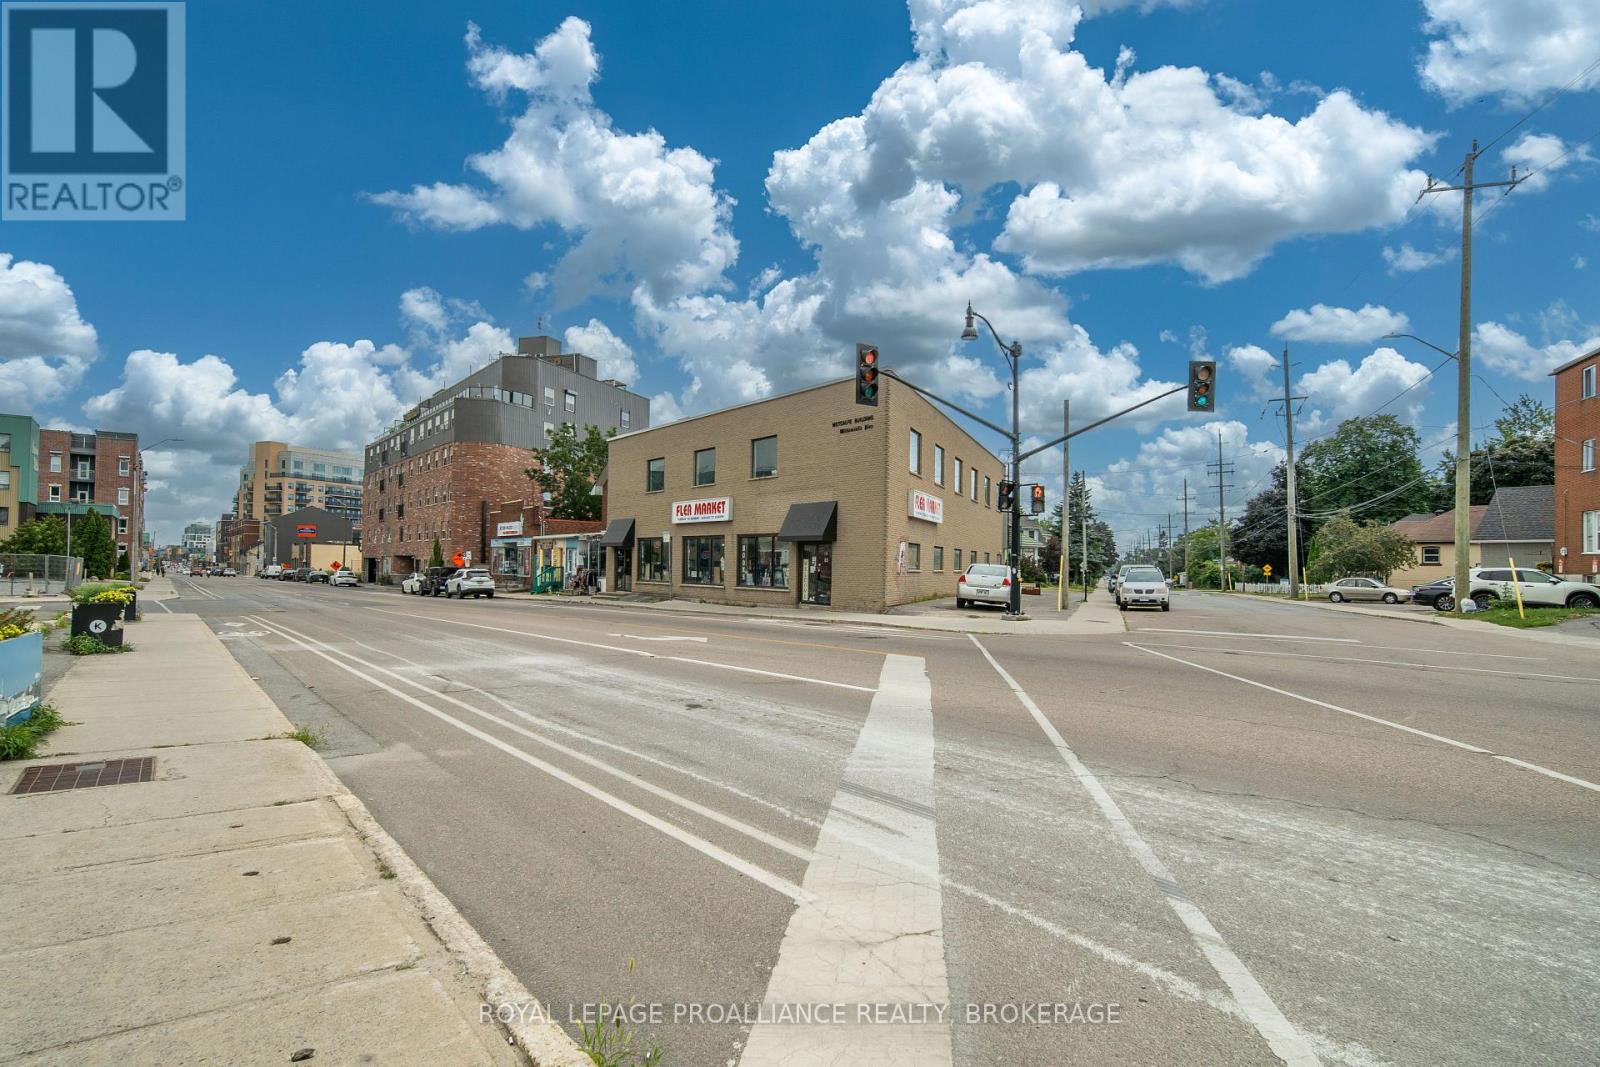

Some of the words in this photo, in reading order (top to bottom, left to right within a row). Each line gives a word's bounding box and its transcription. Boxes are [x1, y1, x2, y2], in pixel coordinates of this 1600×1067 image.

[676, 504, 692, 516] FLEA
[694, 500, 726, 515] MARKET
[94, 622, 102, 630] K
